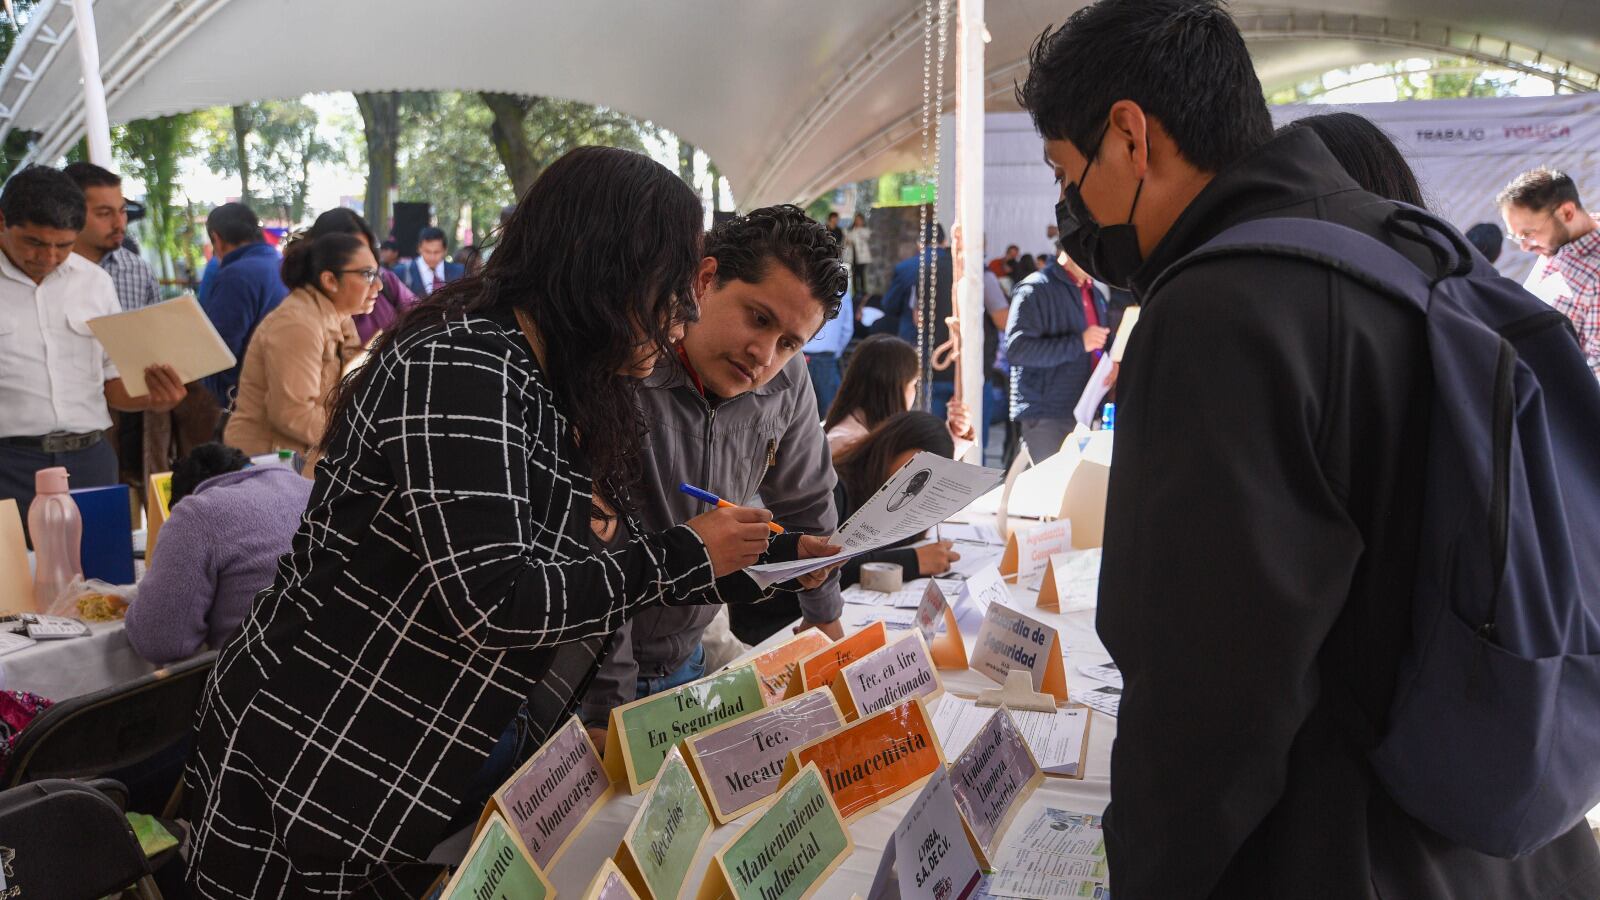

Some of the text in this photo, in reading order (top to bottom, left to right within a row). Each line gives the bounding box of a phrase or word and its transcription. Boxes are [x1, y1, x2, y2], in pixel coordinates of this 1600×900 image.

[1416, 128, 1485, 142] TRABAJO
[1504, 124, 1571, 142] TOLUCA
[1032, 627, 1046, 646] de
[858, 672, 882, 693] Tec.
[883, 663, 896, 679] en
[897, 649, 918, 673] Aire
[862, 668, 932, 716] Acondicionado
[648, 695, 745, 749] En Seguridad
[752, 729, 789, 753] Tec.
[993, 729, 1004, 747] de
[512, 741, 588, 825] Mantenimiento
[725, 755, 787, 796] Mecatr
[825, 731, 927, 796] lmacenista
[976, 759, 1008, 804] Limpieza
[531, 766, 600, 853] a Montacargas
[984, 774, 1018, 830] Industrial
[735, 793, 826, 890] Mantenimiento
[915, 836, 952, 888] S.A. DE C.V.
[917, 828, 942, 863] LYRBA,
[758, 831, 823, 900] Industrial
